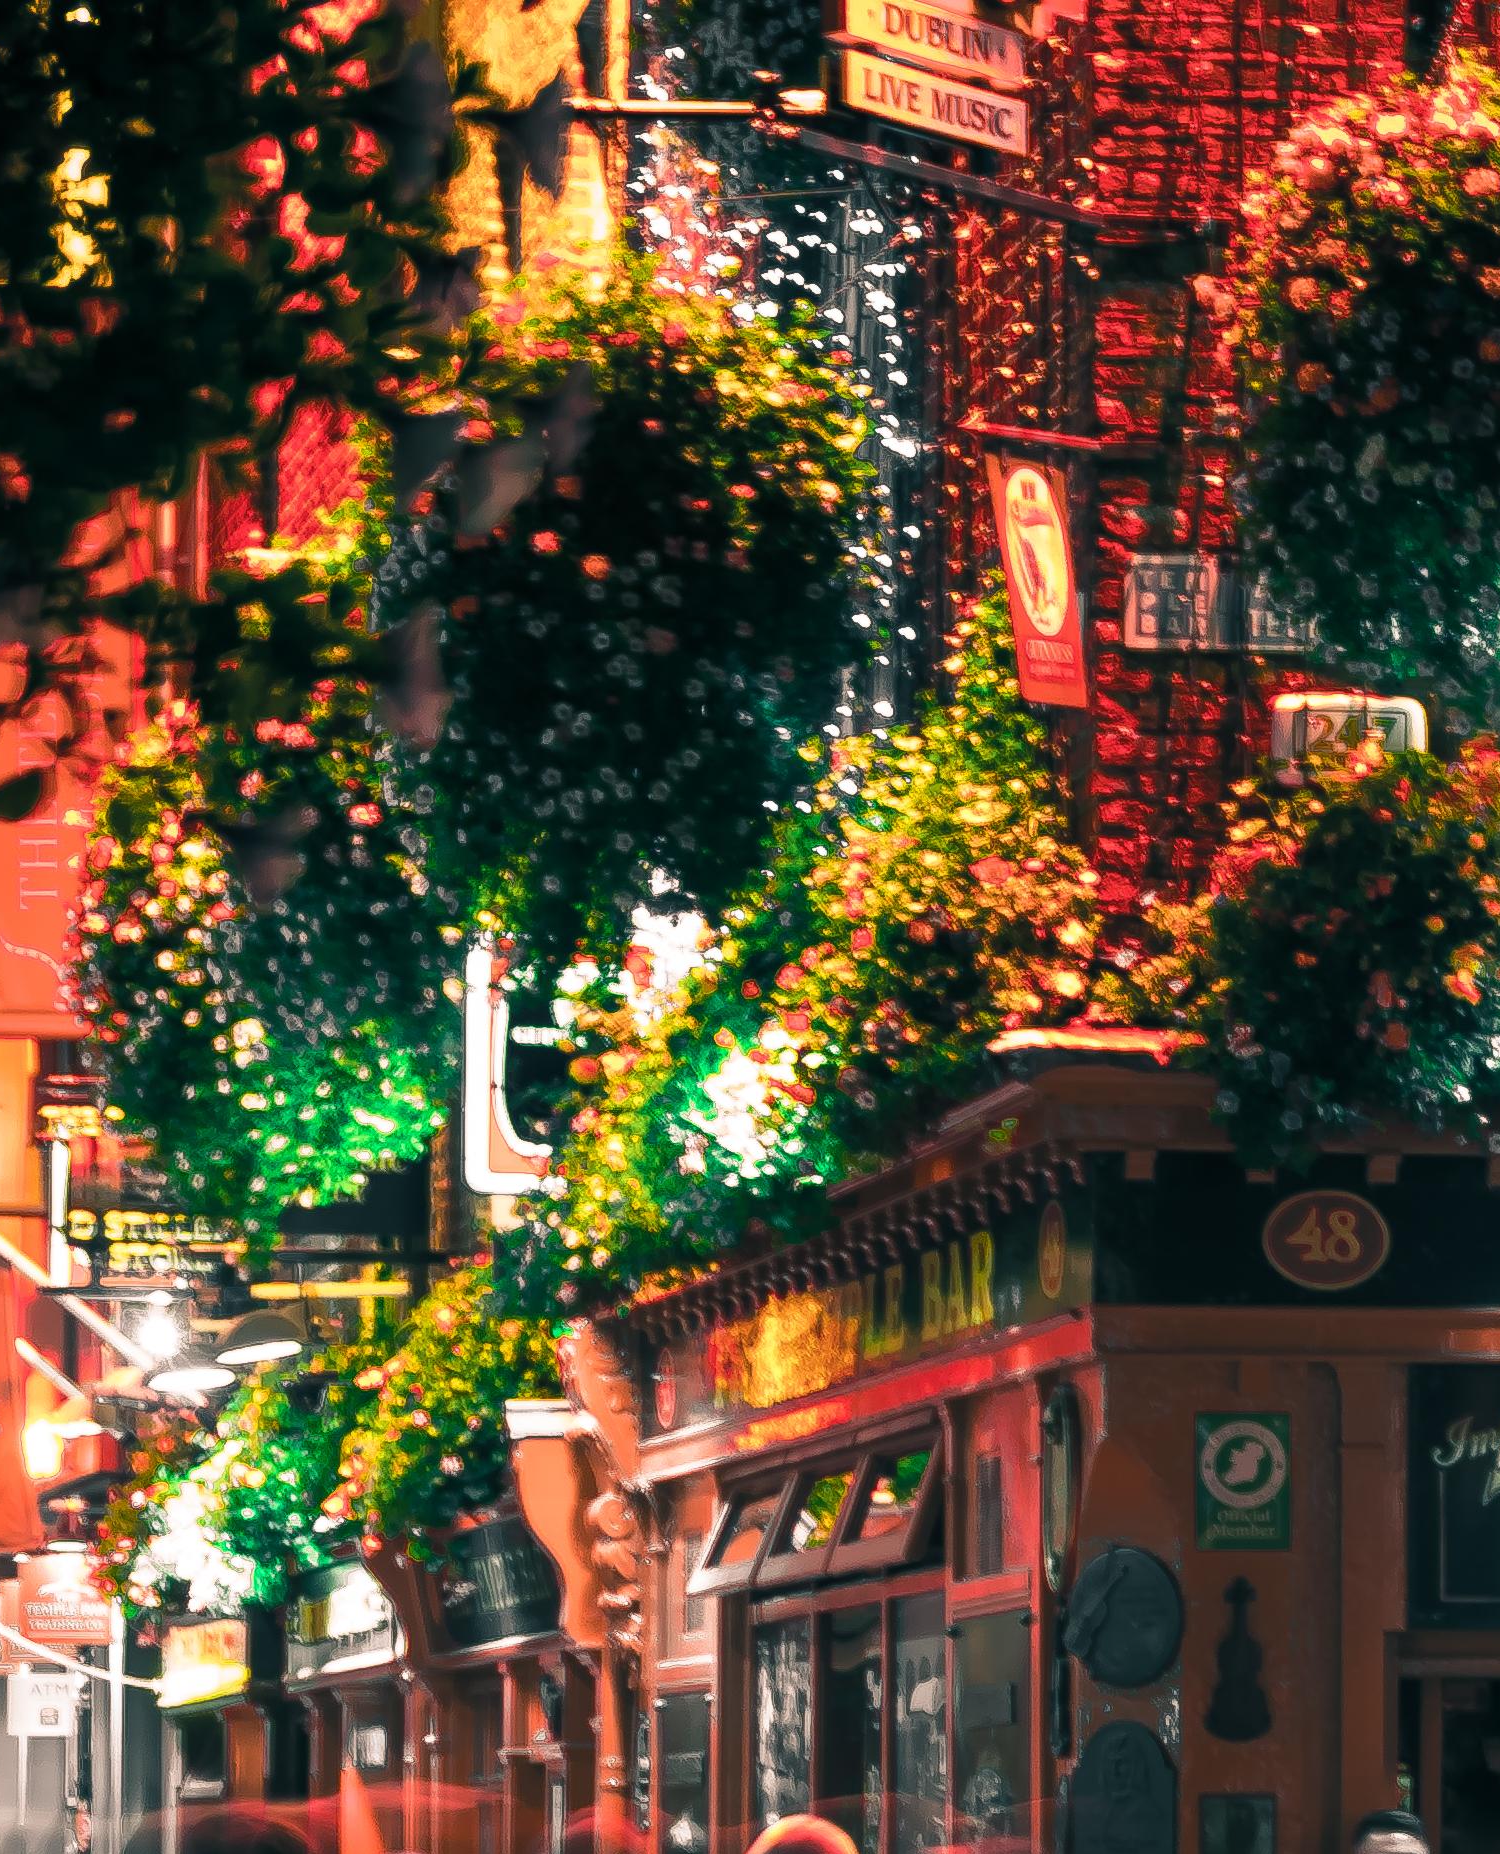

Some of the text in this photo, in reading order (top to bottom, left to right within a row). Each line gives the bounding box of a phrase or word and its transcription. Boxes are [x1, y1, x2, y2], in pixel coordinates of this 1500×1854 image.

[884, 3, 991, 62] DUBLIN
[863, 68, 1014, 138] LIVE MUSIC
[1286, 1207, 1361, 1263] 48
[29, 1682, 71, 1697] ATM
